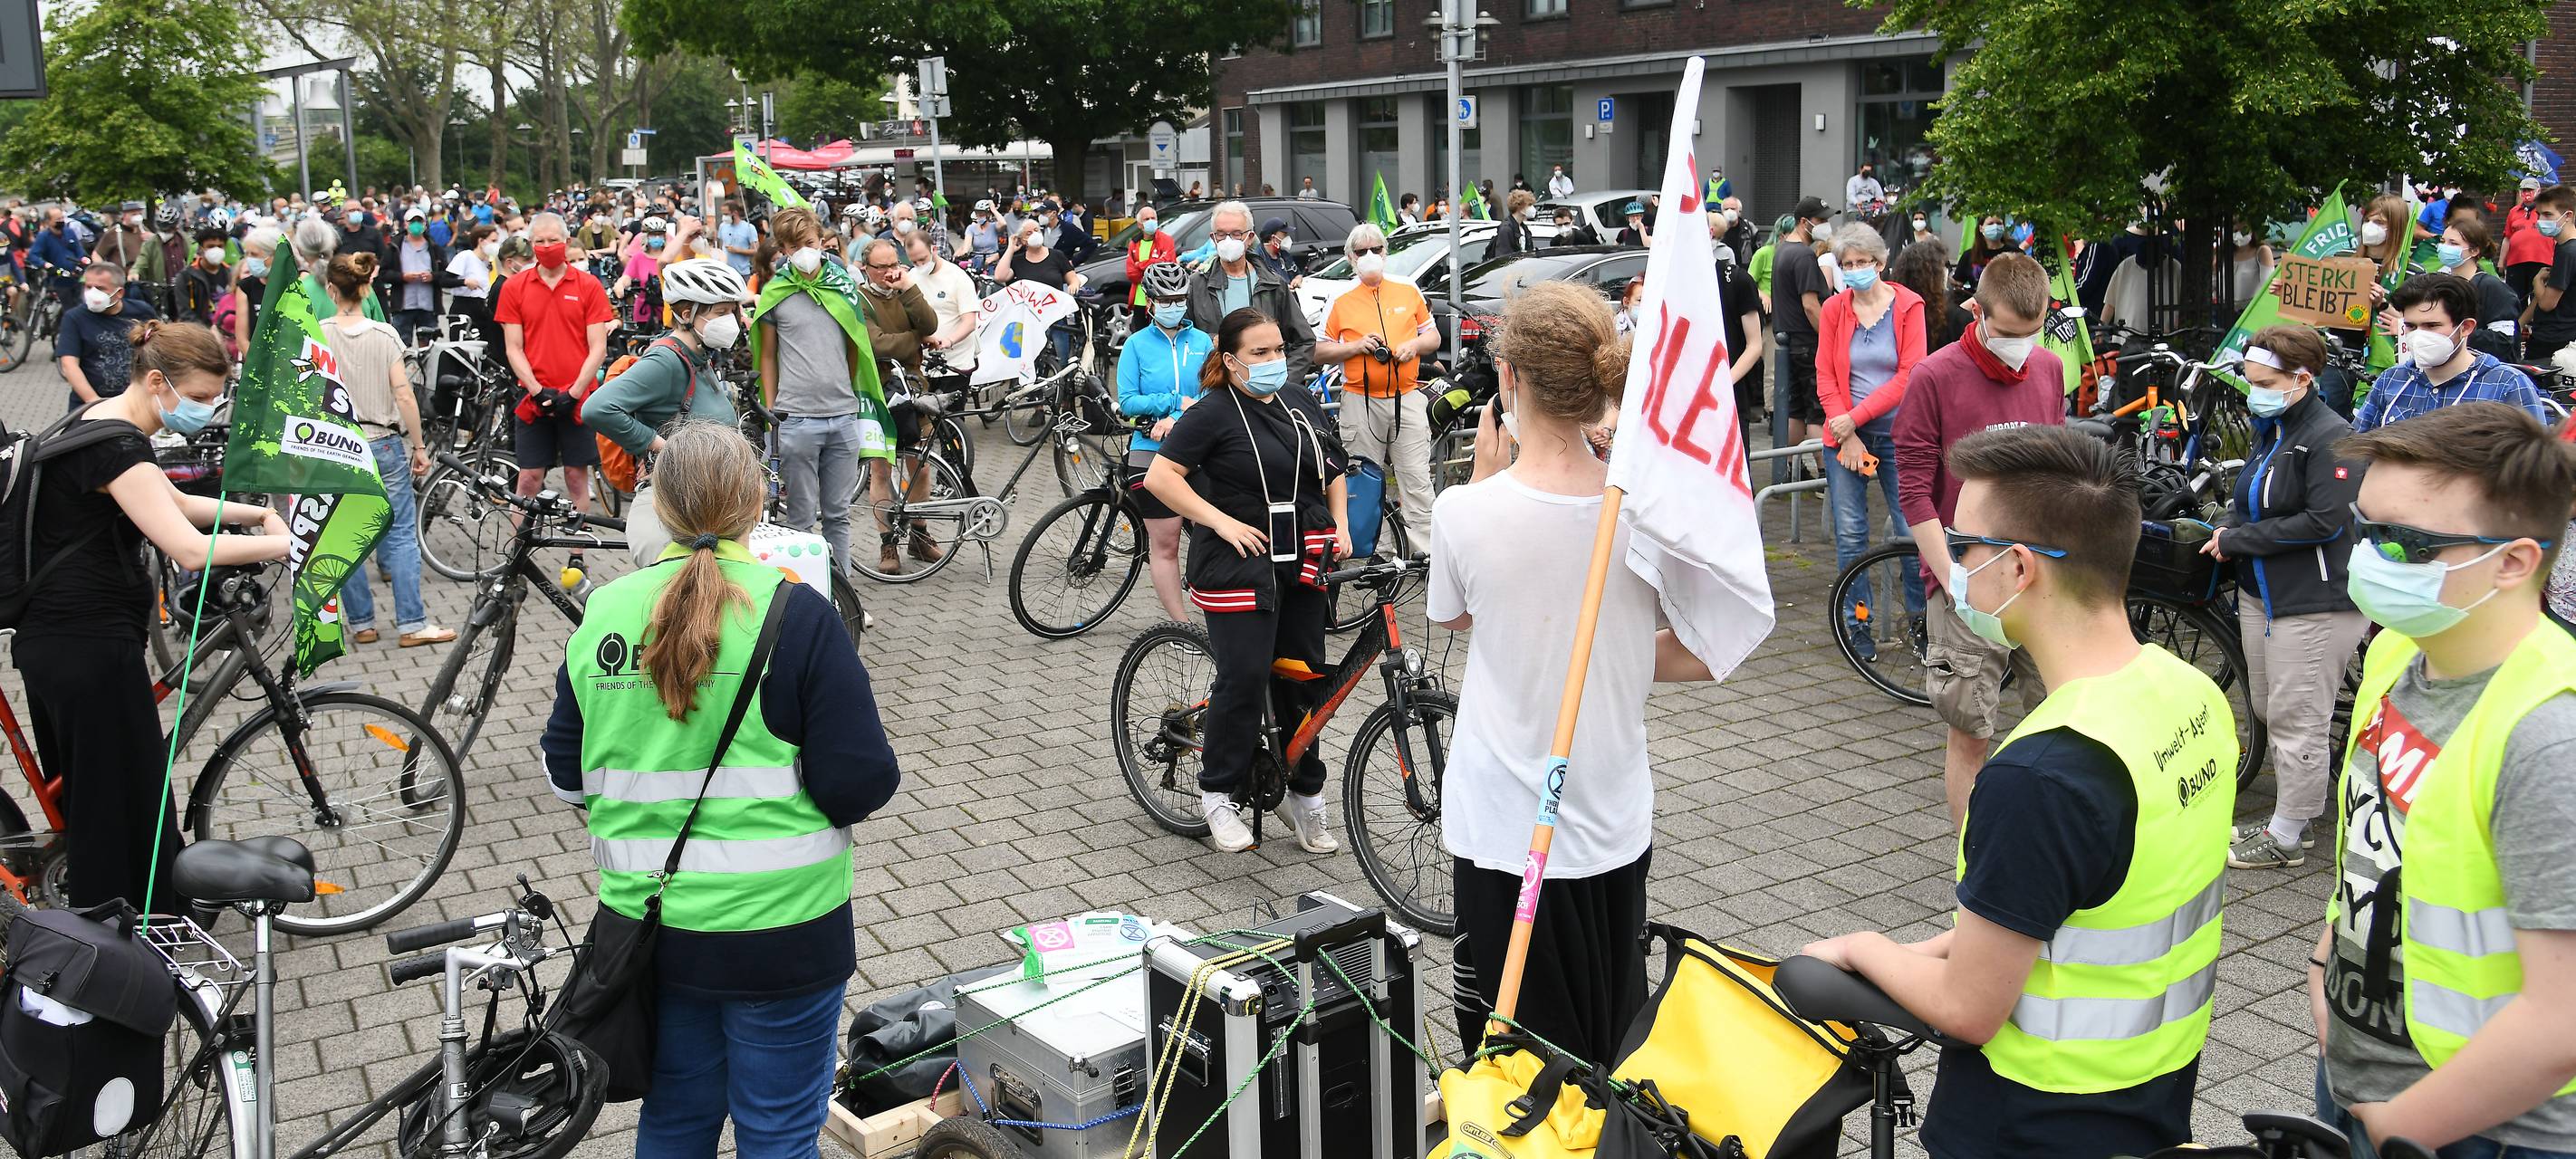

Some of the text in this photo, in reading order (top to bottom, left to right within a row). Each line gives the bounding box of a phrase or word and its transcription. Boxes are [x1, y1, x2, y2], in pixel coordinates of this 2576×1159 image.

[1600, 101, 1610, 119] P
[2285, 261, 2356, 290] STERKI
[2283, 282, 2357, 315] BLEIBT
[290, 444, 309, 452] FRIENDS
[326, 449, 341, 458] EARTH
[341, 454, 363, 463] GERMANY
[314, 431, 363, 454] BUND
[595, 681, 625, 691] FRIENDS
[626, 681, 637, 690] OF
[639, 680, 654, 689] THE
[2189, 758, 2216, 798] BUND
